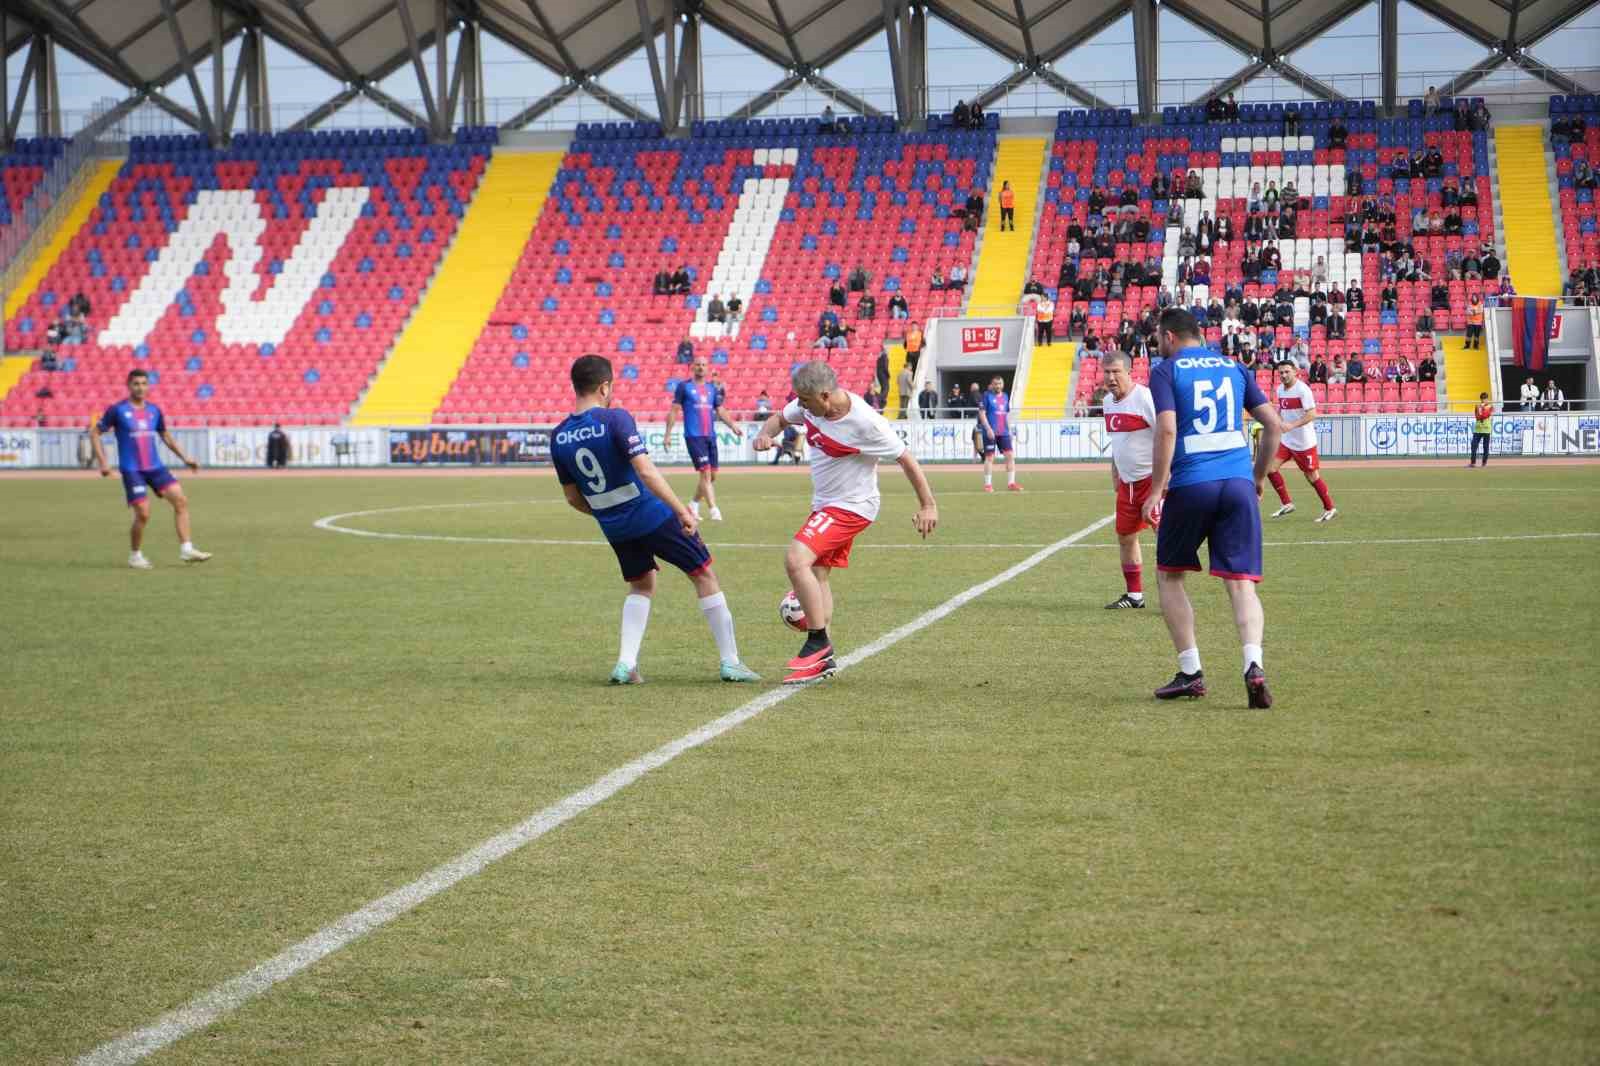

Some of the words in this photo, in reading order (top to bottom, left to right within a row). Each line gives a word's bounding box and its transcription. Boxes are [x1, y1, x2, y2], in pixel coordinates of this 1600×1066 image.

[1192, 376, 1235, 434] 51
[1561, 430, 1600, 450] NE
[575, 447, 606, 493] 9
[807, 511, 834, 533] 51
